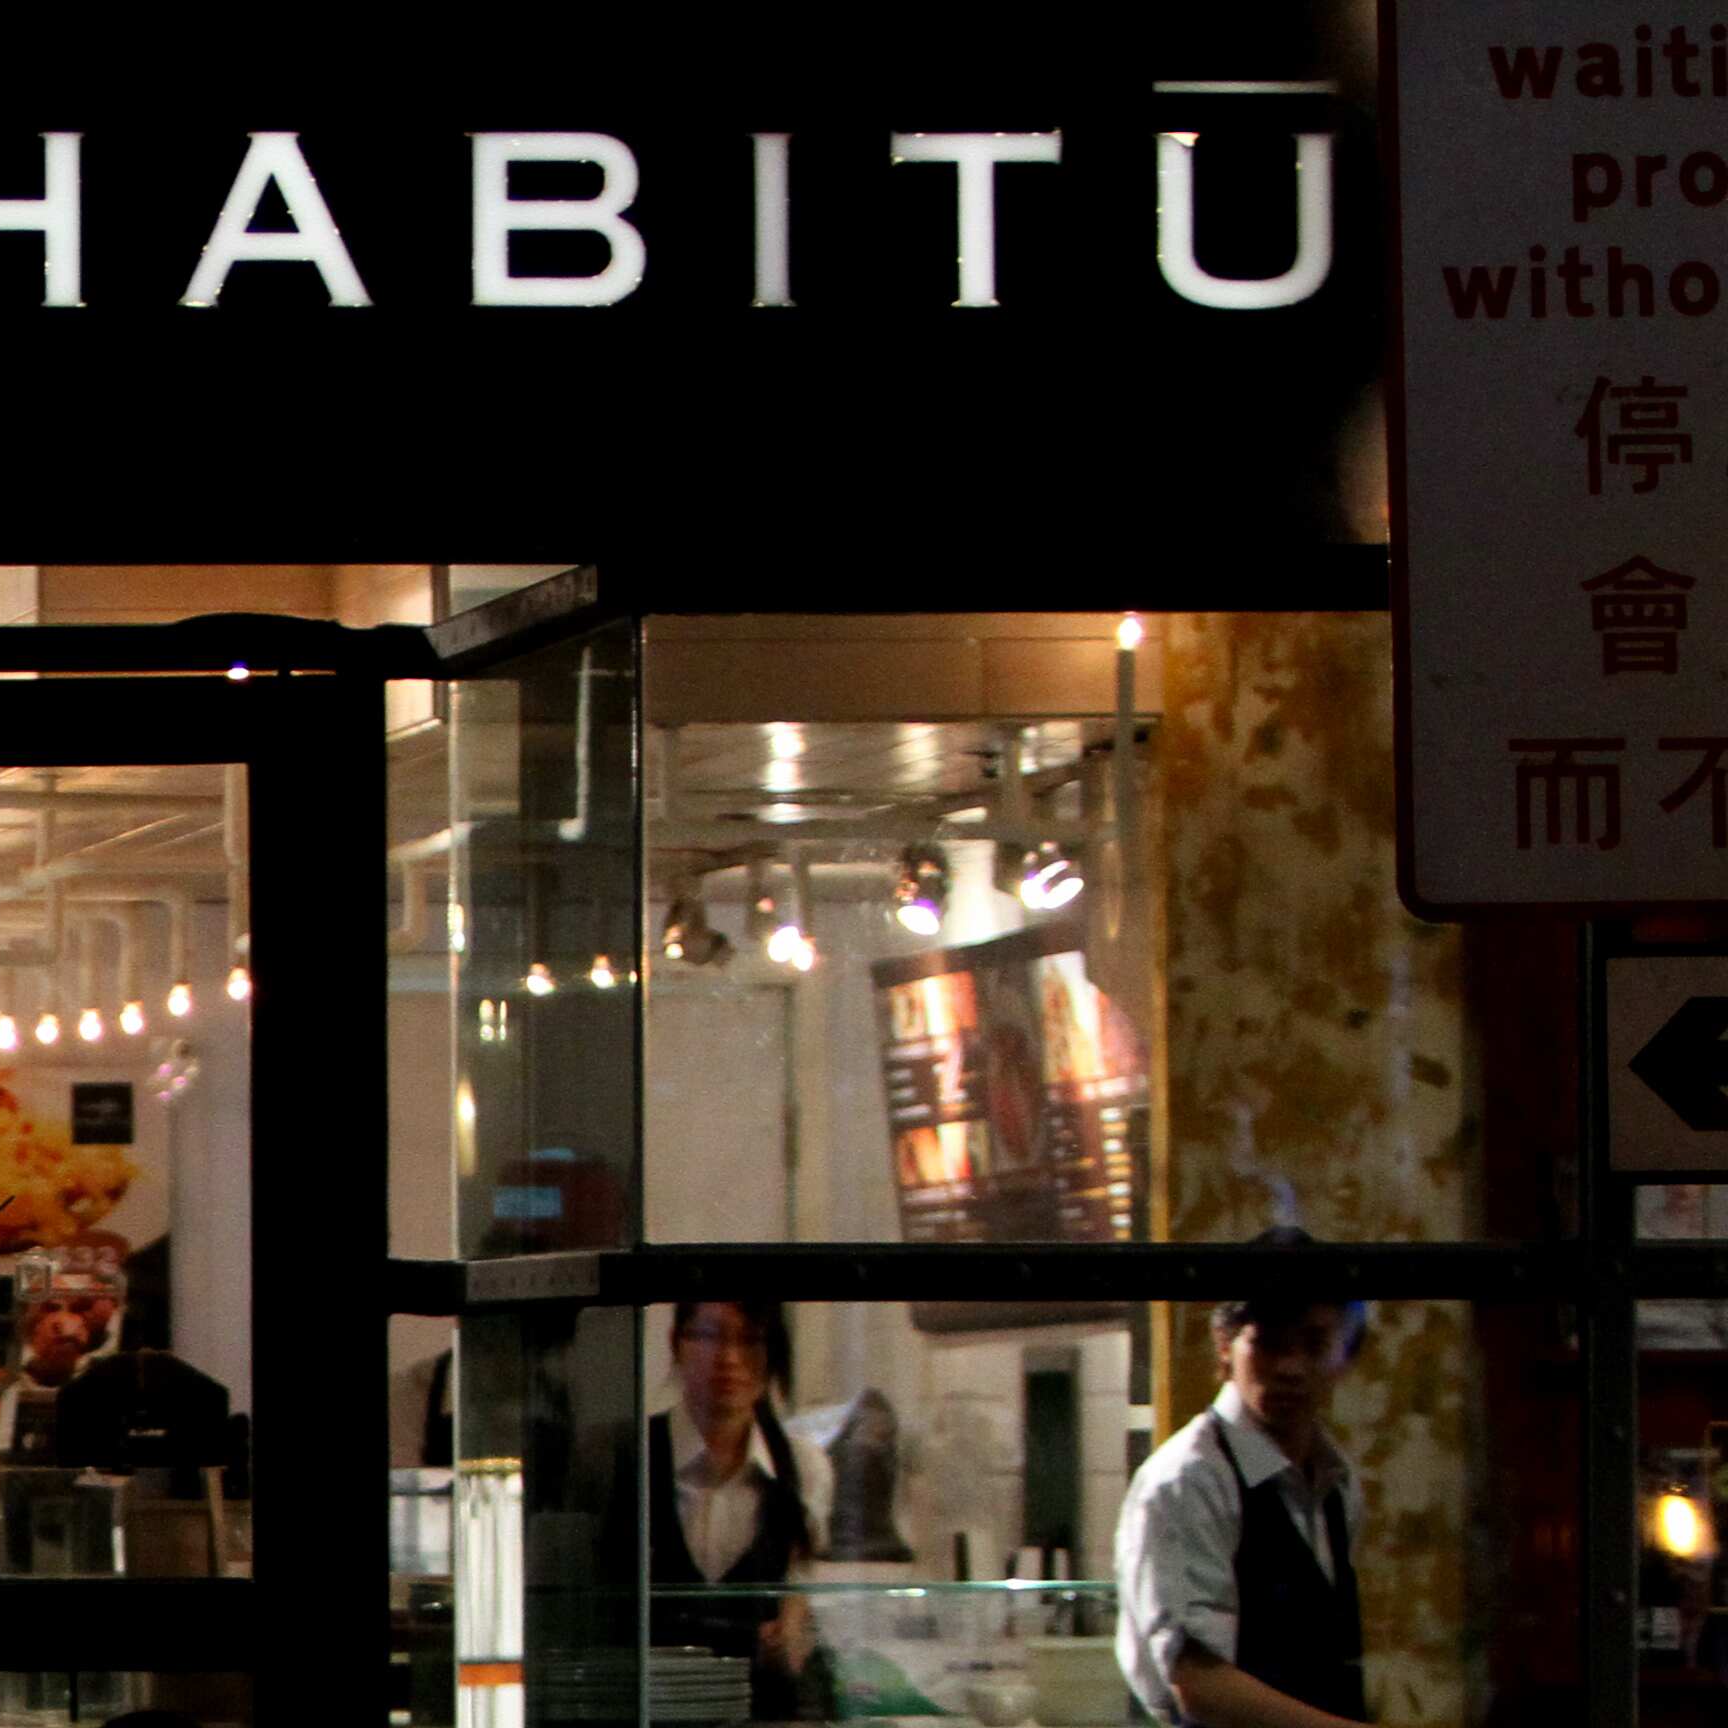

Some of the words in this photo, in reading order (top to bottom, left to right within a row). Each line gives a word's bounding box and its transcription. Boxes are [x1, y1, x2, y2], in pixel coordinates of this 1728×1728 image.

[1572, 151, 1728, 223] pro
[1441, 243, 1720, 319] witho
[1573, 375, 1693, 496] 停
[1580, 554, 1697, 675] 會
[1508, 736, 1728, 850] 而不
